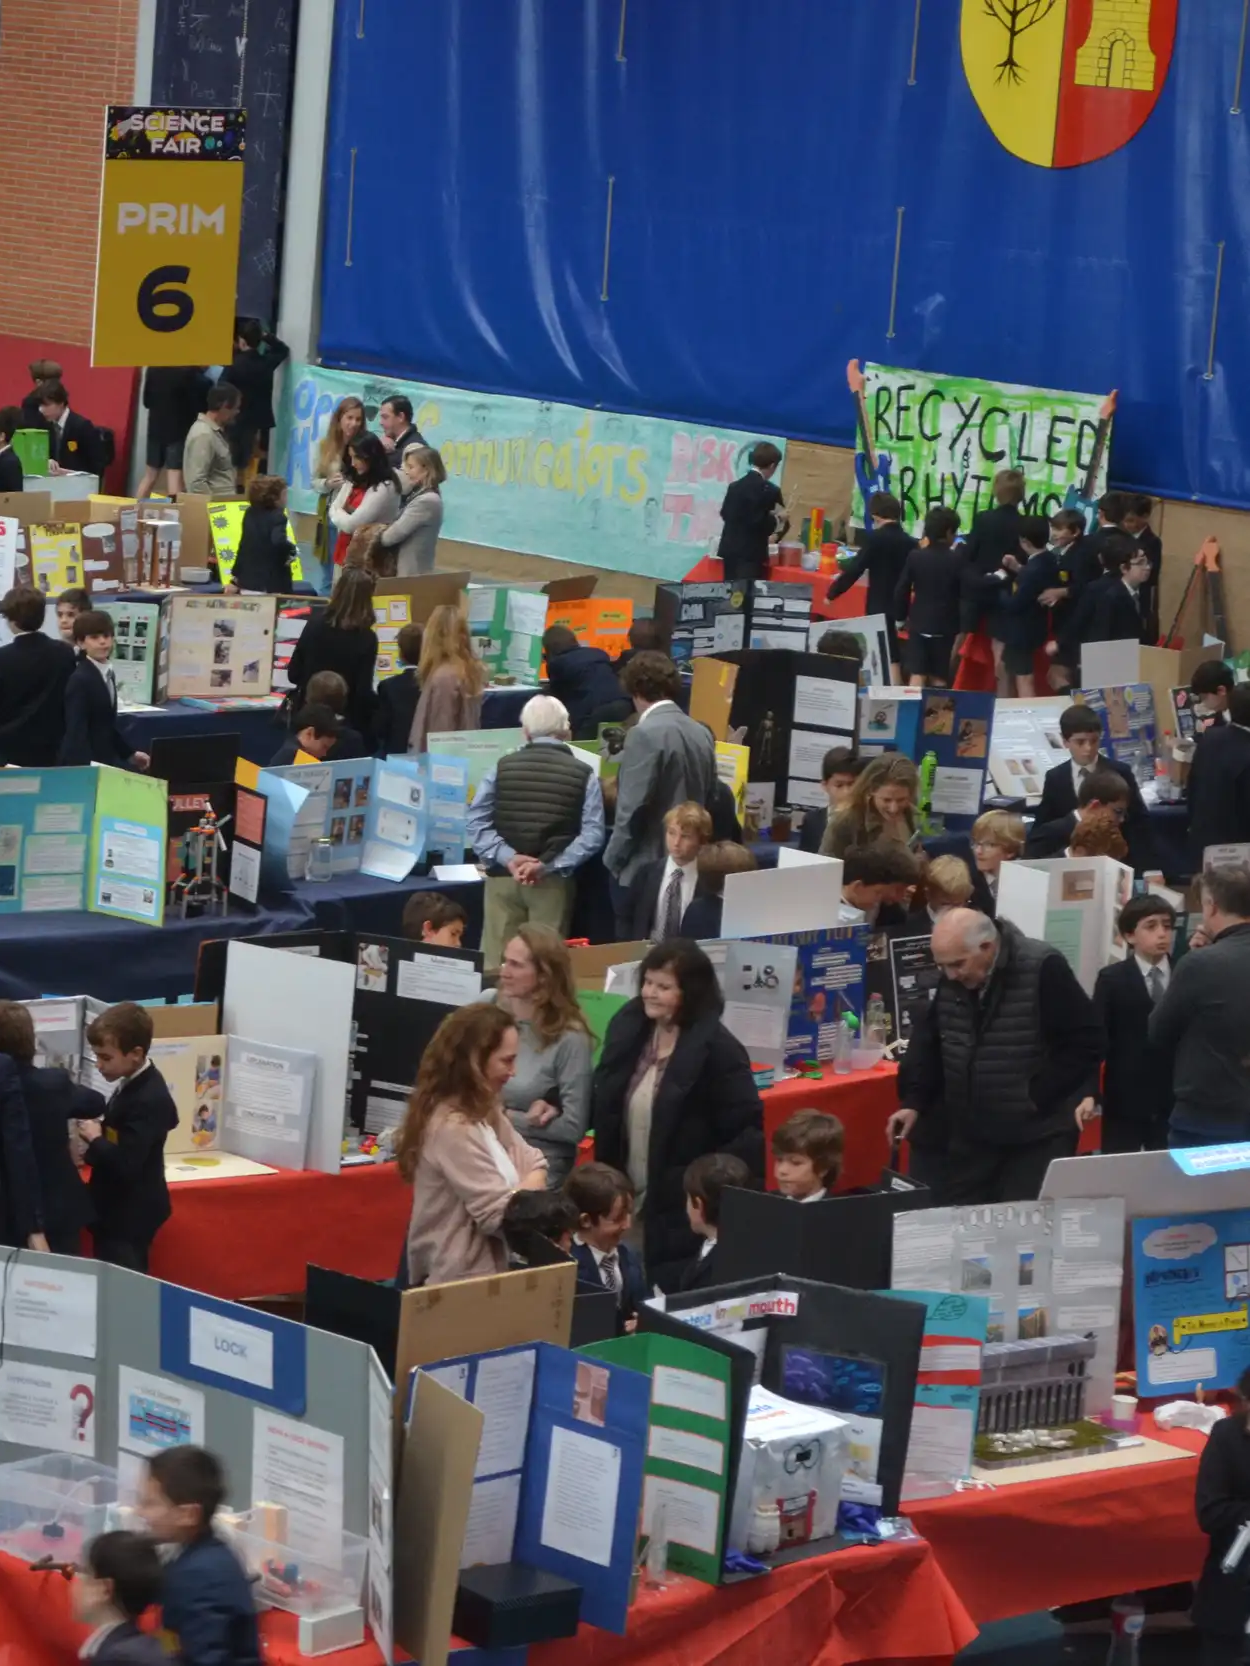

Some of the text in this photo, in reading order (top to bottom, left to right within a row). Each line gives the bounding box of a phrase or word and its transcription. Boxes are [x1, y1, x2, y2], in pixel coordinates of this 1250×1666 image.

[129, 113, 226, 132] SCIENCE
[150, 137, 202, 154] FAIR
[116, 202, 226, 236] PRIM
[136, 264, 195, 333] 6
[874, 384, 1099, 471] RECYCLED
[667, 431, 738, 483] RISK
[748, 1297, 796, 1316] mouth
[213, 1336, 249, 1359] LOCK
